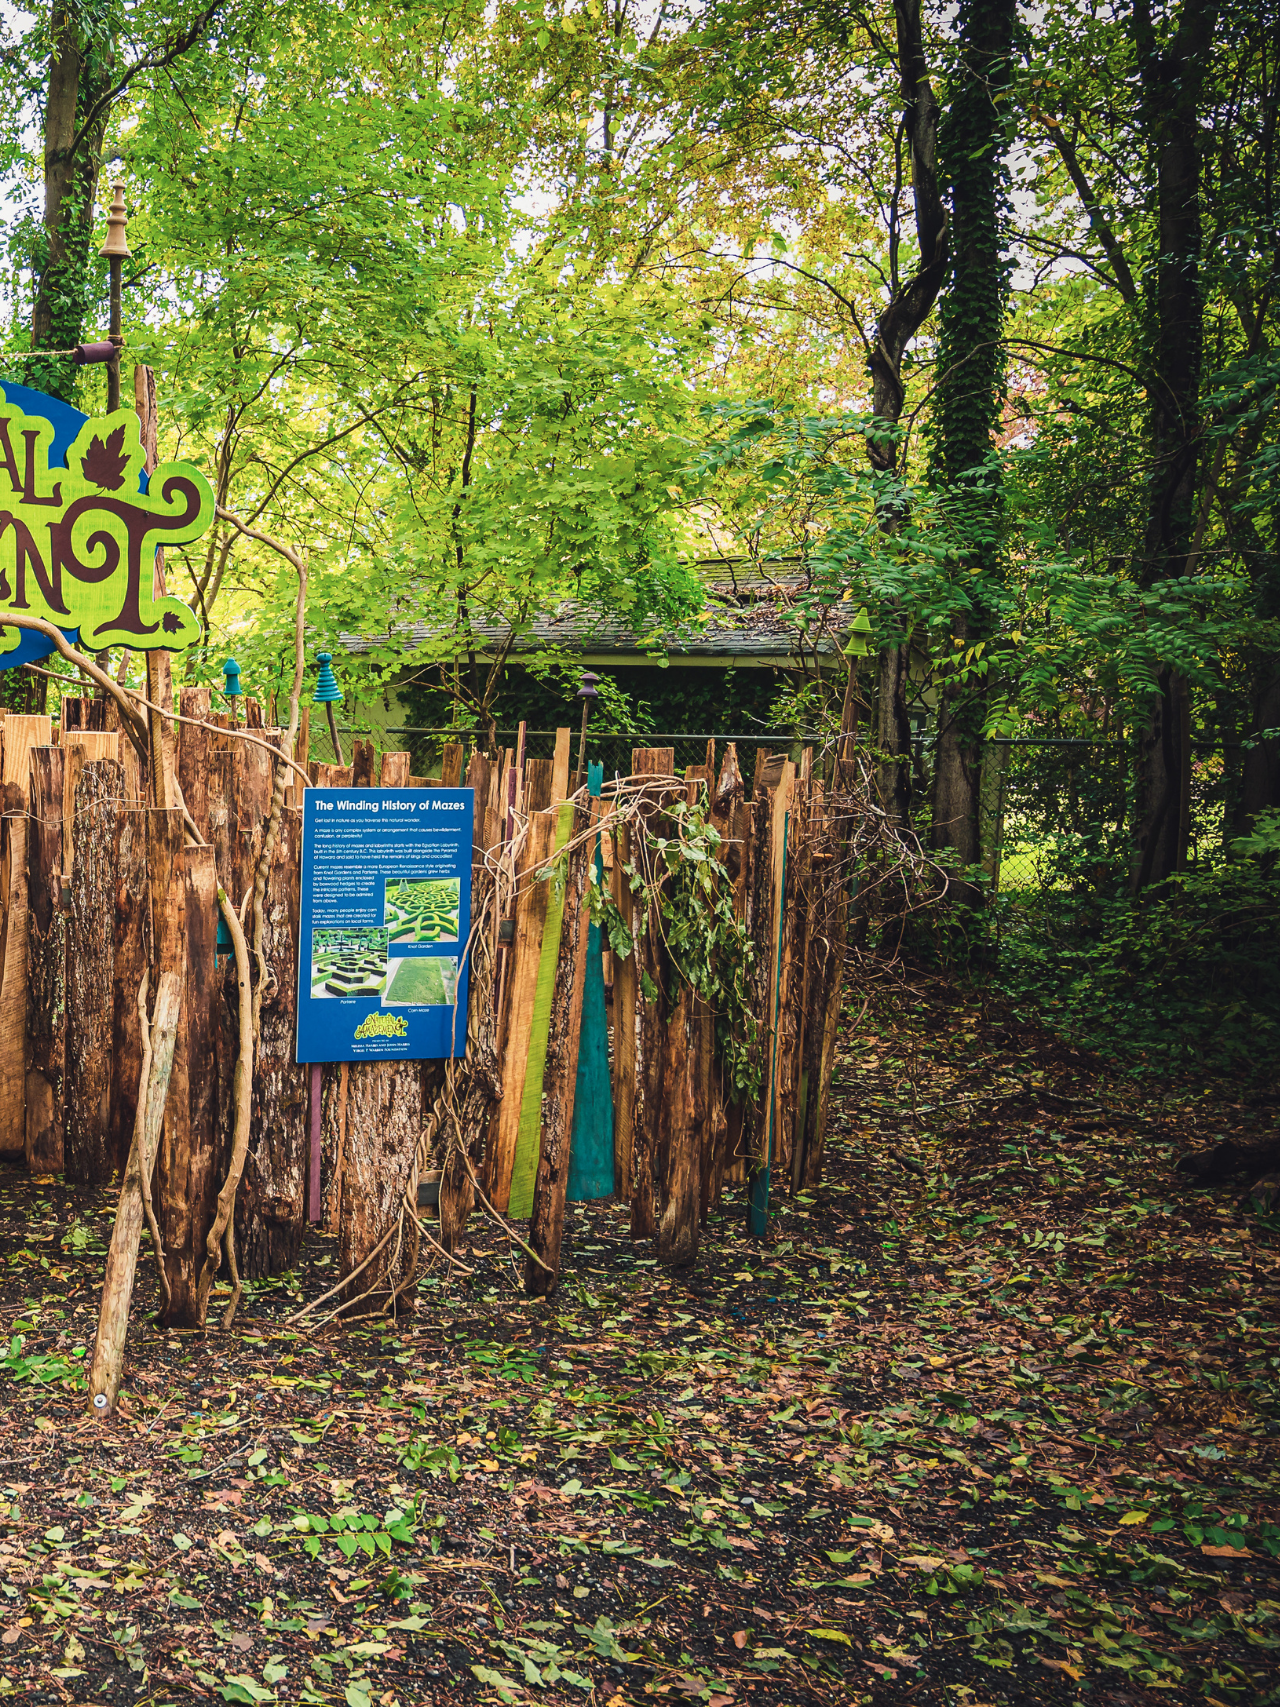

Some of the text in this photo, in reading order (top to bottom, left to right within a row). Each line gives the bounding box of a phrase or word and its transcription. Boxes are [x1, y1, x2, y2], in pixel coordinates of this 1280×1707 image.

[315, 800, 465, 813] The Winding History of Mazes
[366, 1014, 397, 1026] NATURAL
[355, 1021, 407, 1038] AMAZEMENT
